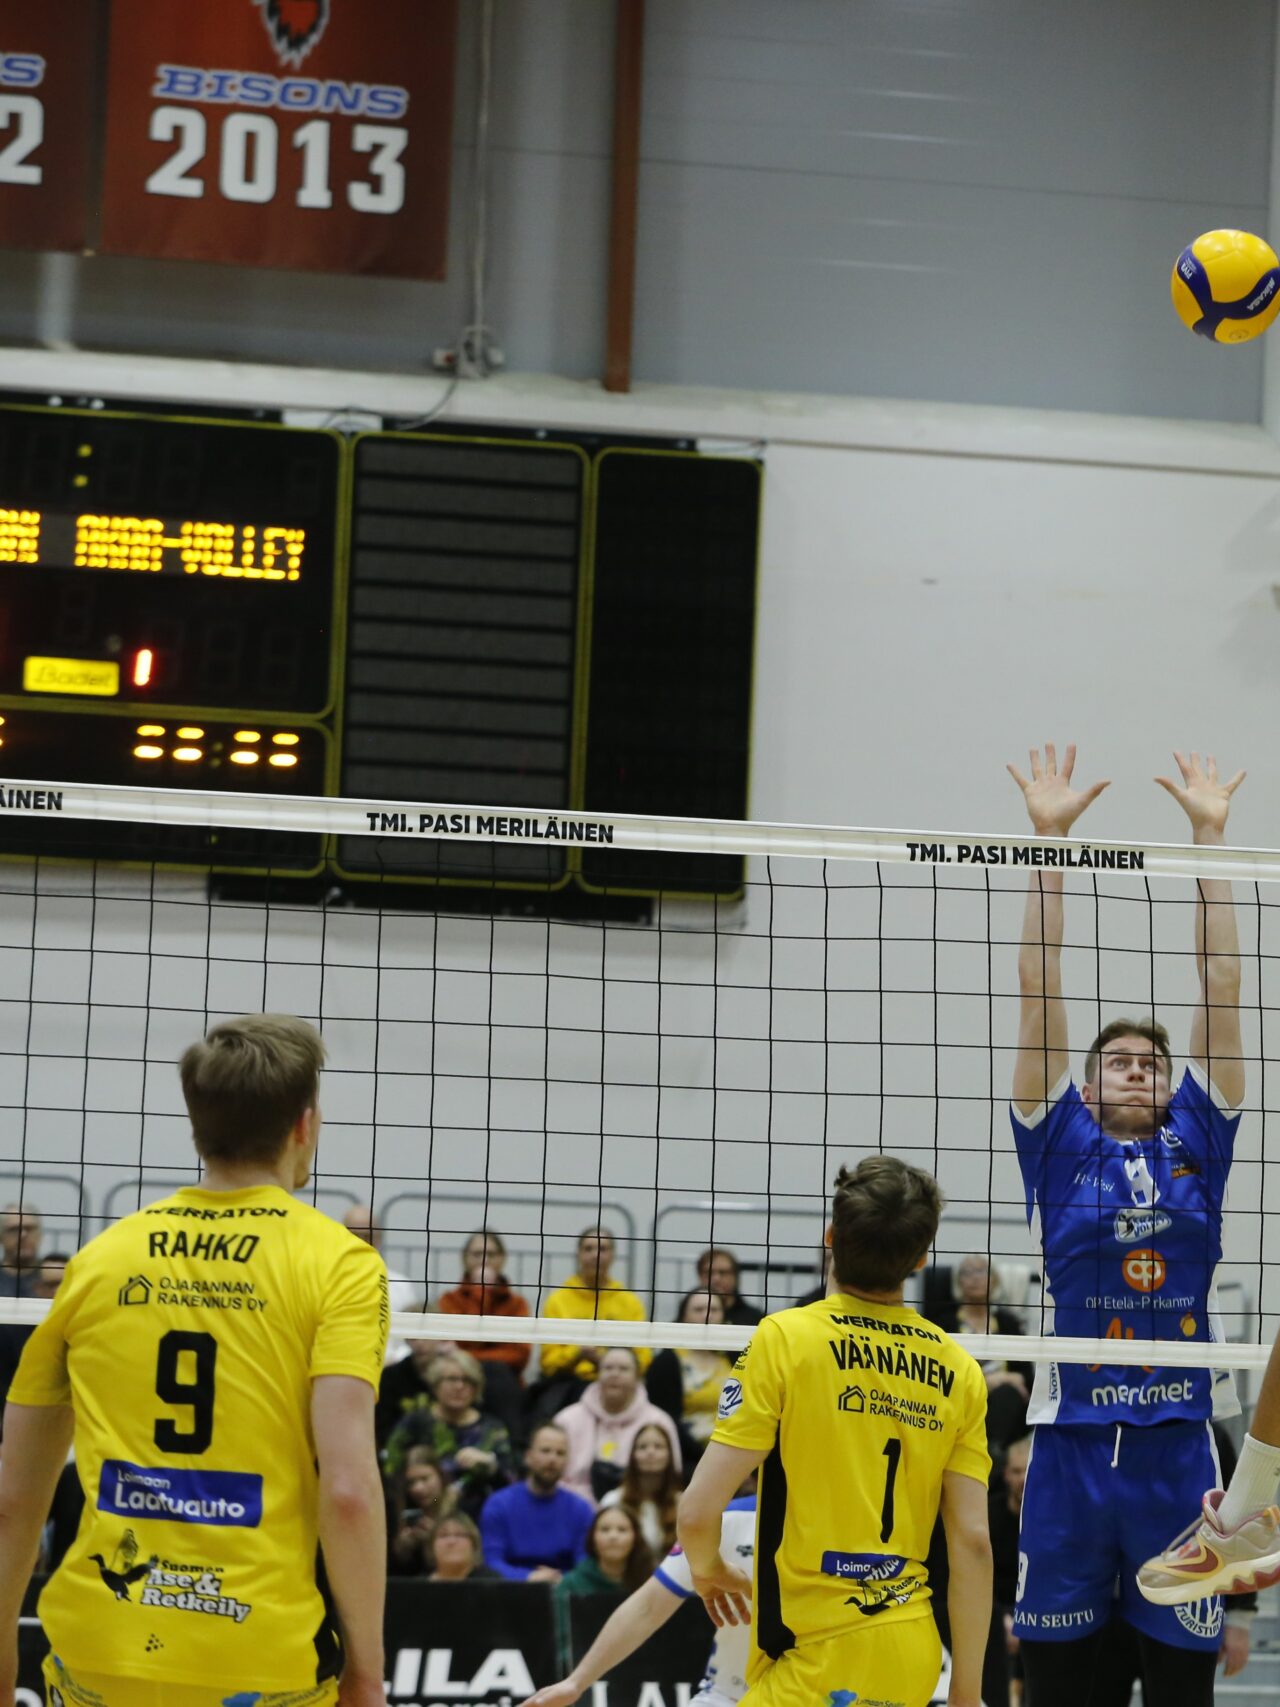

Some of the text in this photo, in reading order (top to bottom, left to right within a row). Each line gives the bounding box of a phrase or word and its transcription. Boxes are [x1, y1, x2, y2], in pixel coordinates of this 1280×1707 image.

[154, 63, 408, 118] BISONS
[146, 106, 408, 214] 2013
[367, 813, 614, 843] TMI. PASI MERILÄINEN
[906, 843, 1144, 870] TMI. PASI MERILÄINEN
[149, 1230, 260, 1264] RAHKO
[159, 1276, 255, 1295] OJARANNAN
[157, 1293, 268, 1312] RAKENNUS OY
[830, 1314, 942, 1345] WERRATON
[829, 1334, 955, 1398] VÄÄNÄNEN
[153, 1329, 217, 1454] 9
[870, 1389, 937, 1416] OJARANNAN
[1092, 1378, 1193, 1407] merimet
[870, 1404, 944, 1433] RAKENNUS OY
[118, 1469, 170, 1490] Loimaan
[880, 1438, 901, 1544] 1
[115, 1482, 245, 1518] Laatuauto
[146, 1569, 194, 1588] Ase
[141, 1588, 251, 1624] Retkeily
[1041, 1608, 1094, 1628] SEUTU
